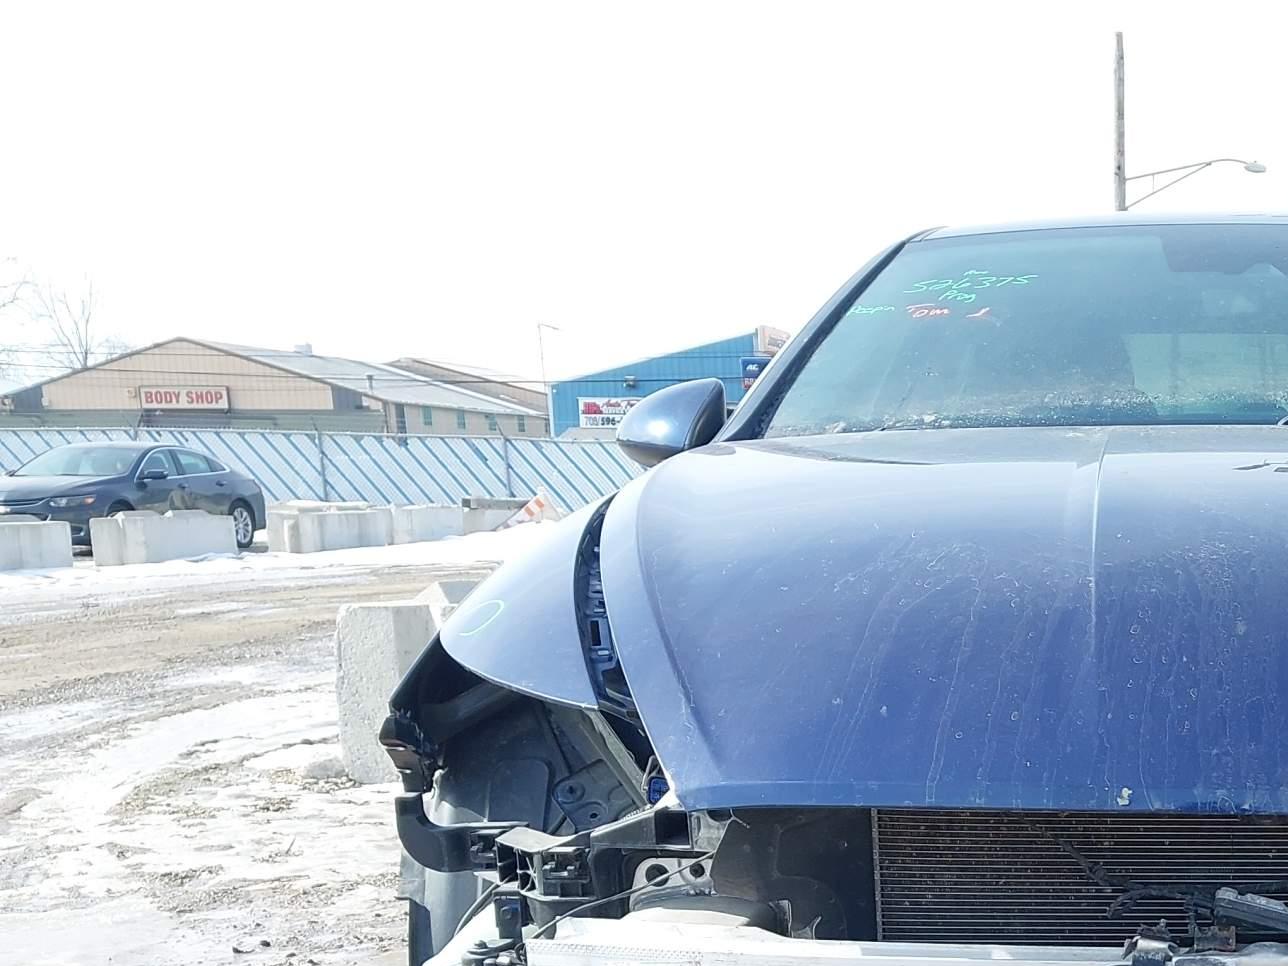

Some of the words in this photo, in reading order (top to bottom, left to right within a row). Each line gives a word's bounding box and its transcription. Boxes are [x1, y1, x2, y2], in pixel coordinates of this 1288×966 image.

[144, 391, 181, 404] BODY
[186, 391, 224, 404] SHOP
[584, 416, 623, 426] 708/596-
